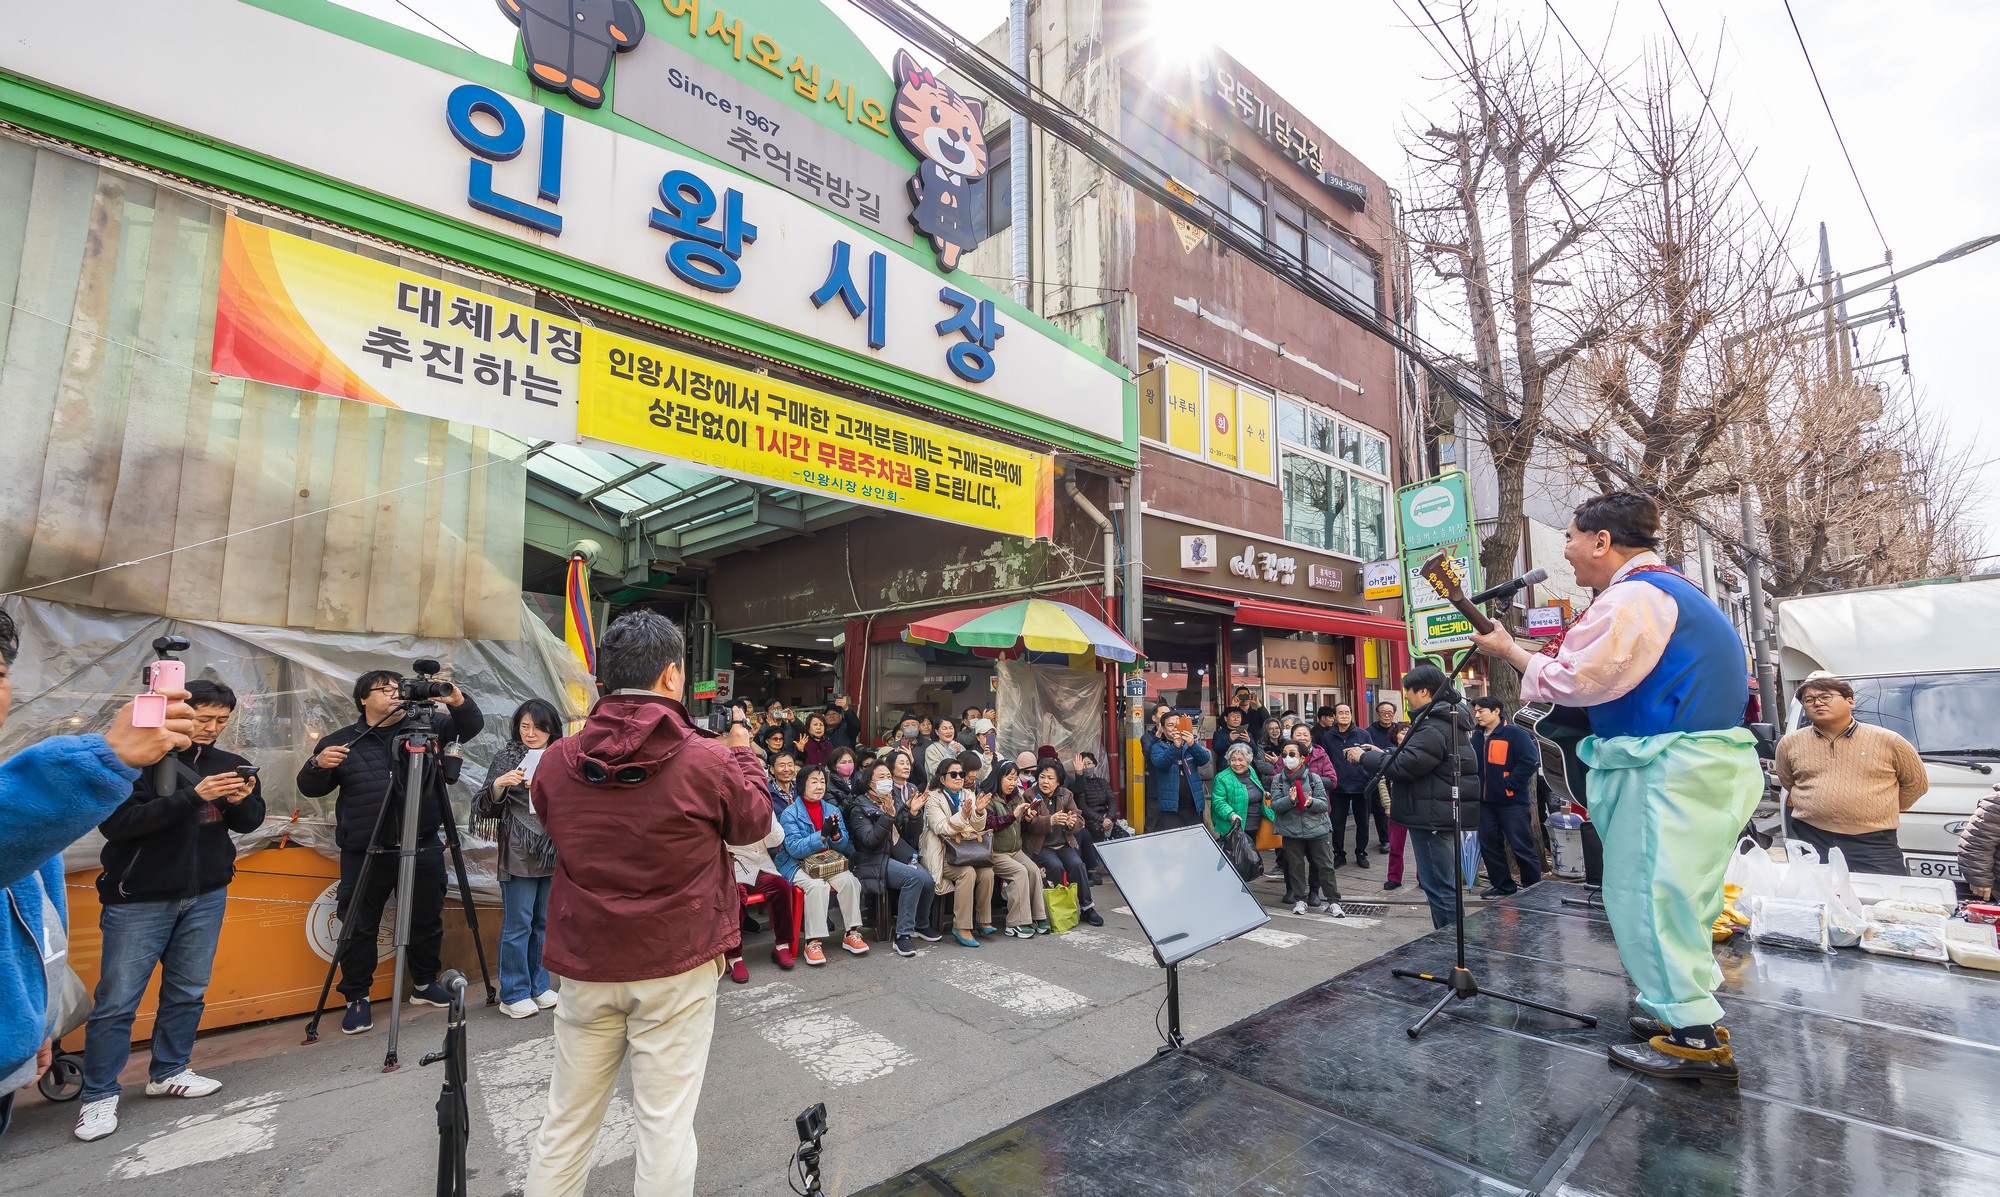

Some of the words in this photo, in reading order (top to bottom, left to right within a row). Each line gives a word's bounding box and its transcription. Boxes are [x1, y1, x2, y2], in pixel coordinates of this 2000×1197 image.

[664, 0, 890, 138] 어서오십시오
[667, 67, 781, 137] Since1967
[726, 126, 882, 225] 추억뚝방길
[446, 84, 1005, 383] 인왕시장
[361, 325, 563, 407] 추진하는
[397, 280, 582, 365] 대체시장
[608, 347, 761, 416] 인왕시장에서
[766, 393, 830, 430] 구매한
[834, 405, 944, 466] 고객분들께는
[947, 442, 1022, 487] 구매금액에
[648, 397, 748, 449] 상관없이
[755, 425, 810, 463] 1시간
[817, 439, 931, 493] 무료주차권을
[934, 470, 1002, 511] 드립니다.
[1132, 687, 1143, 695] 18
[1265, 656, 1297, 670] TAKE
[1312, 659, 1335, 672] OUT
